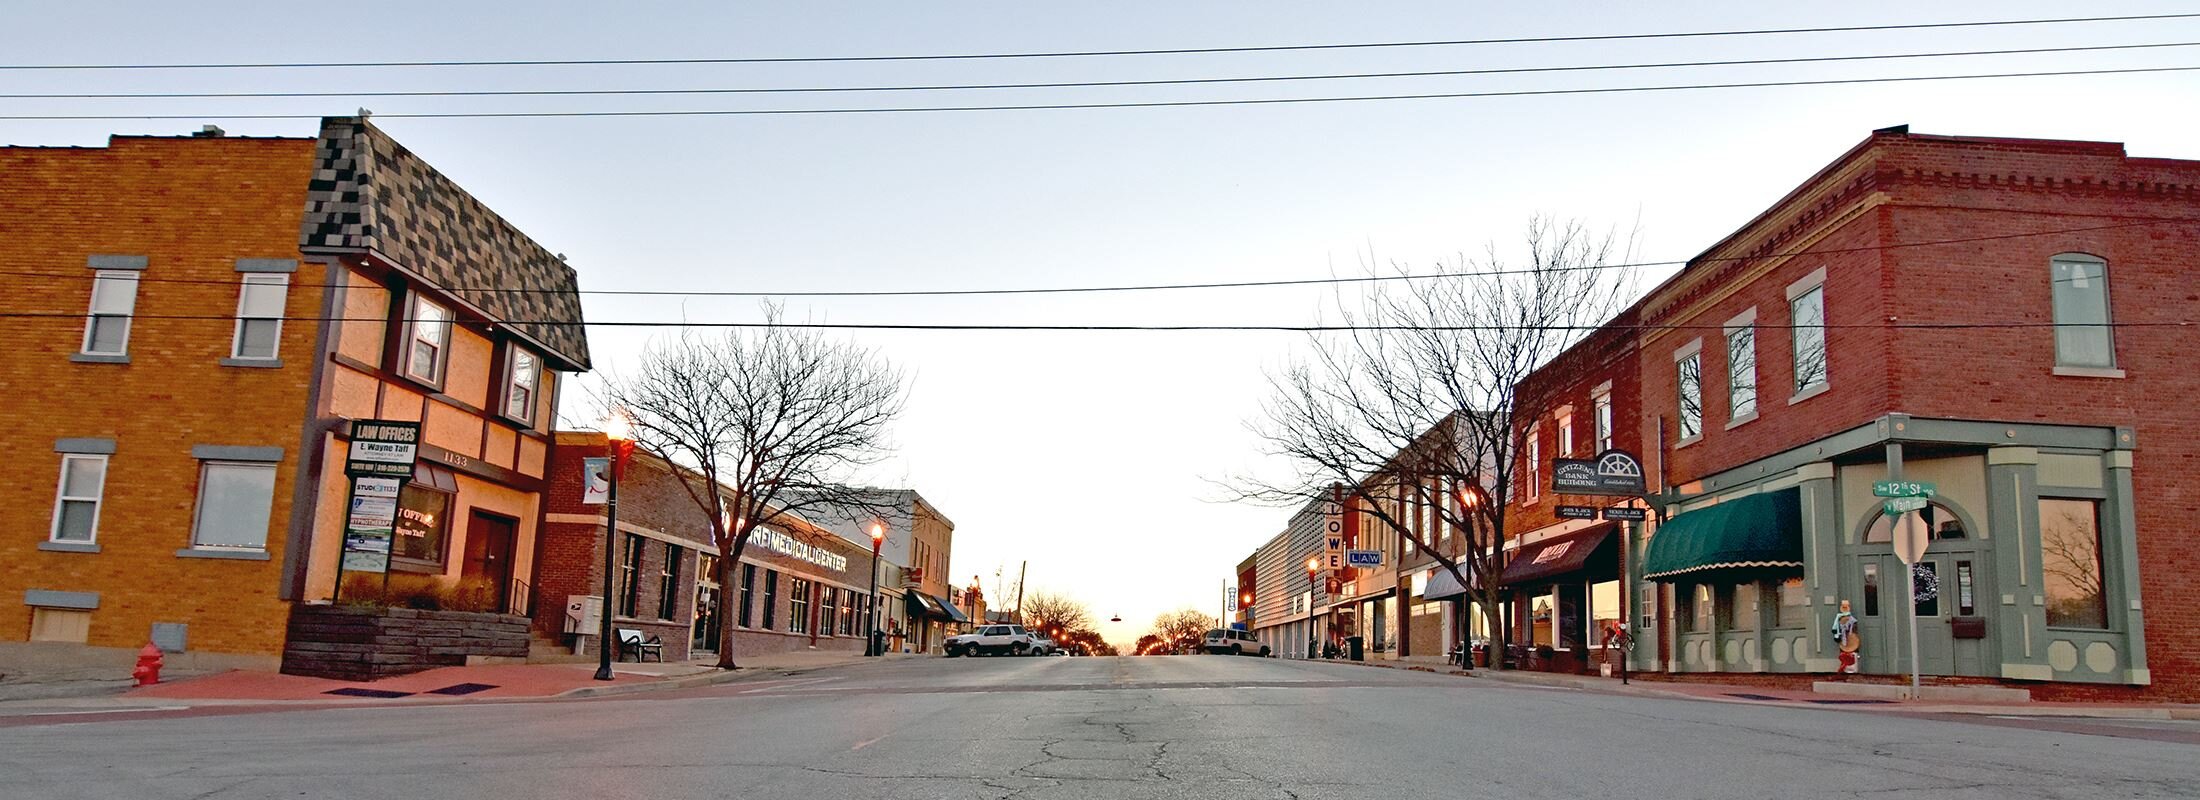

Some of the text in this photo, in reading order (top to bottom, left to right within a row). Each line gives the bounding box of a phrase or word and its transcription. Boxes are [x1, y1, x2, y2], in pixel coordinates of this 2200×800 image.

[356, 425, 416, 441] LAW OFFICES
[367, 444, 393, 452] Wayne
[394, 445, 409, 453] Taff
[444, 452, 467, 467] 1133
[1910, 483, 1921, 495] St
[412, 529, 426, 538] Taff
[1328, 504, 1341, 567] LOWE
[815, 547, 847, 573] CENTER
[1351, 554, 1379, 563] LAW
